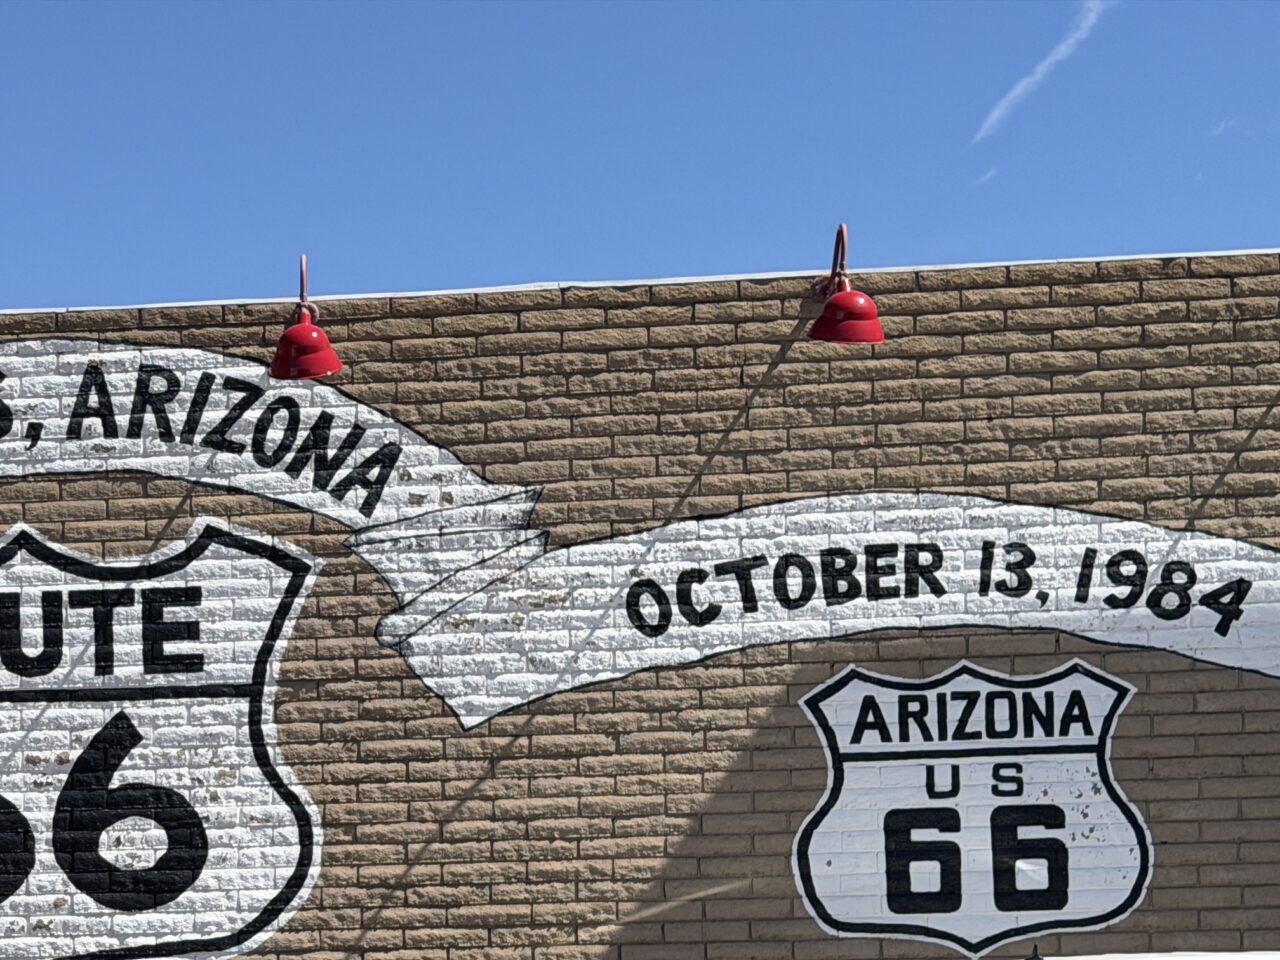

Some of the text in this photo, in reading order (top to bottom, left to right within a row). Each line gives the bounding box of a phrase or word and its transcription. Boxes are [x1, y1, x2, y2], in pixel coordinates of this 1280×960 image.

[65, 360, 403, 518] ARIZONA
[624, 540, 1253, 638] OCTOBER 13, 1984
[848, 689, 1095, 745] ARIZONA
[883, 804, 1069, 916] 66
